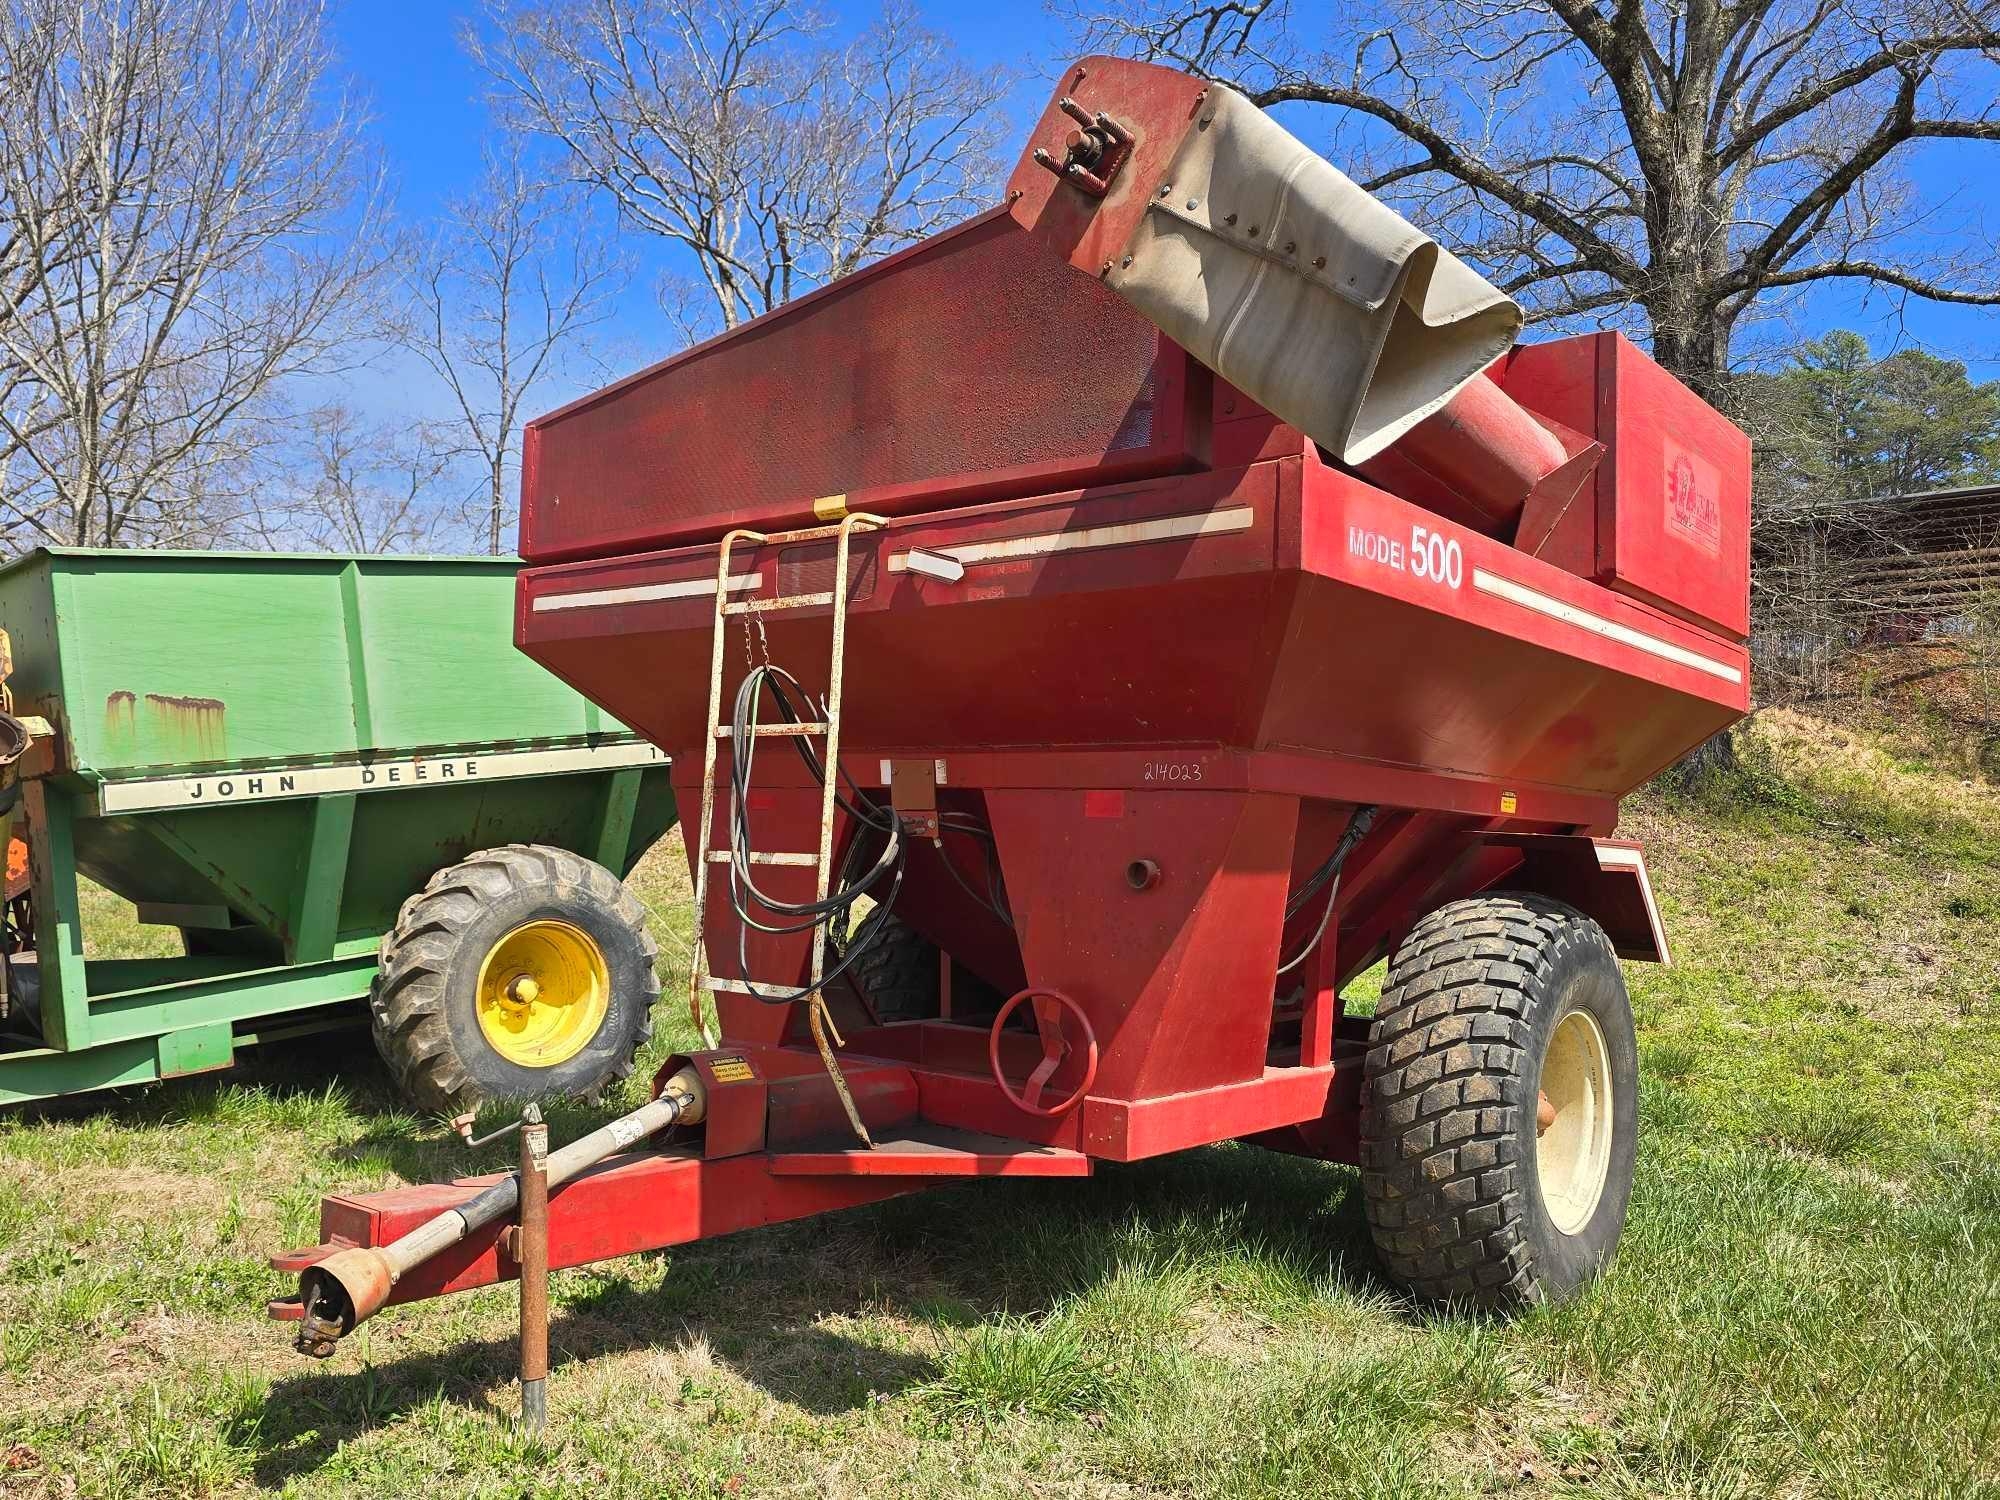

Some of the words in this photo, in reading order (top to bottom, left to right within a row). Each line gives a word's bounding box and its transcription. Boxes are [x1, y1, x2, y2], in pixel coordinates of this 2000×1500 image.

[1410, 525, 1463, 590] 500
[190, 776, 295, 799] JOHN
[361, 761, 478, 784] DEERE
[1144, 762, 1202, 781] 214023
